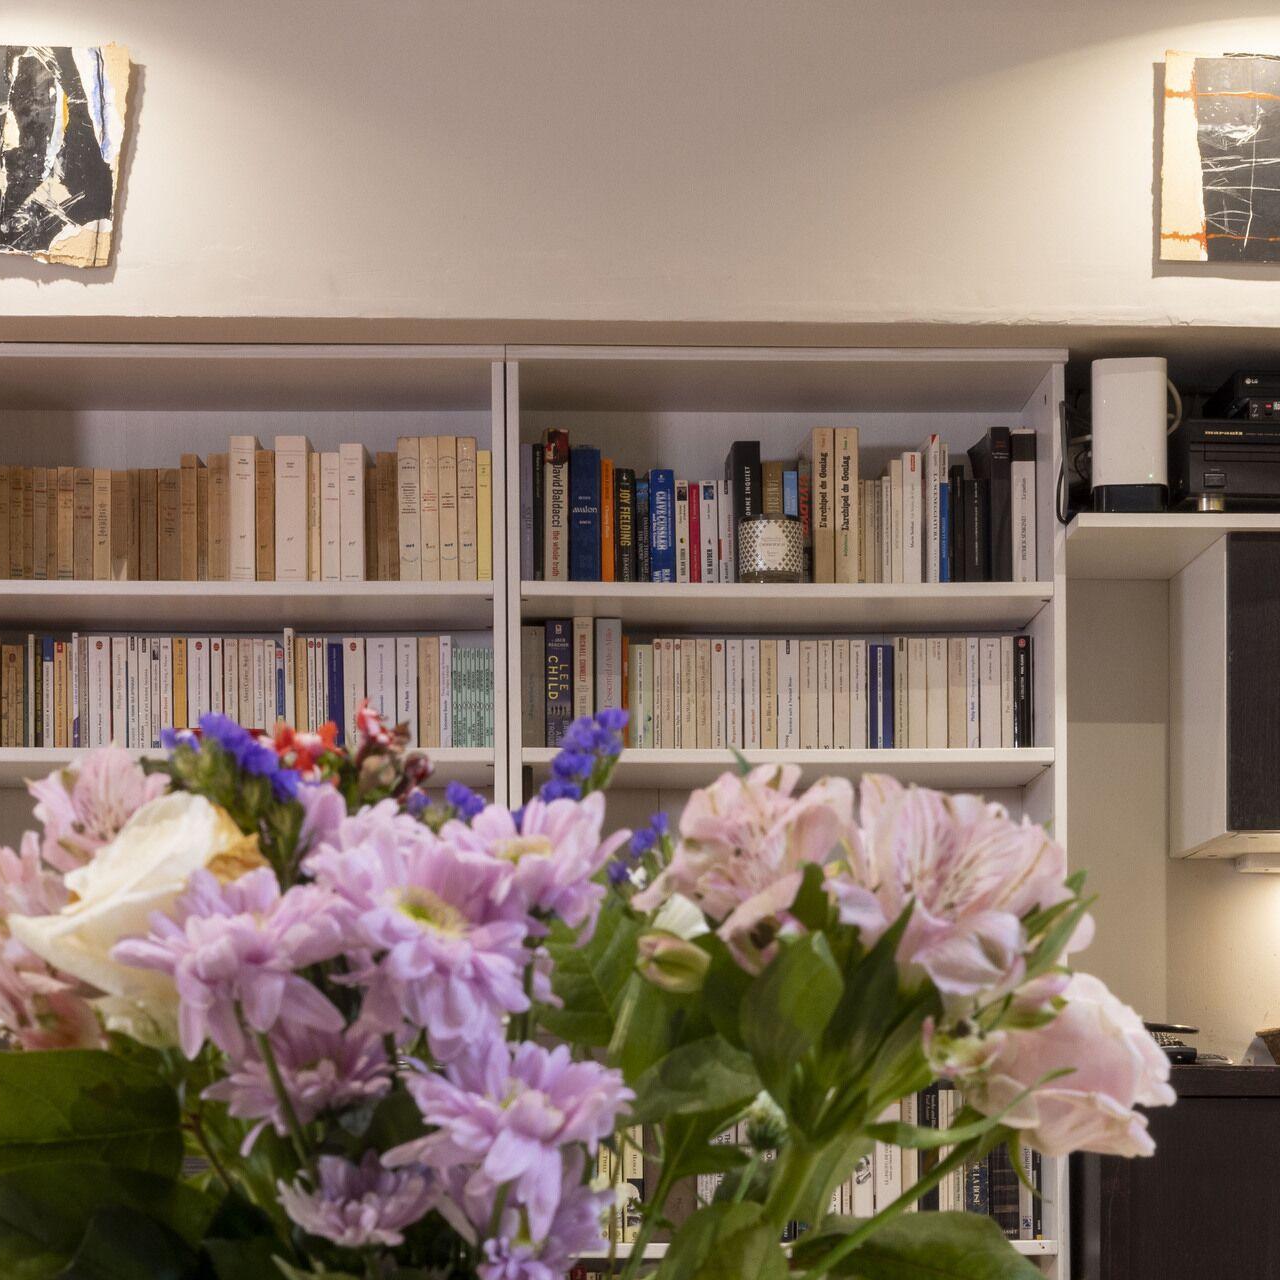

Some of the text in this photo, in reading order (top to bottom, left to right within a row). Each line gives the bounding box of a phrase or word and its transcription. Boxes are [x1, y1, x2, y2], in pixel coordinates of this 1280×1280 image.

[744, 465, 752, 495] INQUIET
[818, 452, 830, 479] Goulag
[840, 455, 852, 482] Goulag
[552, 463, 563, 528] David Baldacci
[818, 491, 830, 528] L'archipel
[840, 494, 852, 531] L'archipel
[619, 489, 631, 546] JOY FIELDING
[548, 655, 559, 700] CHILD
[560, 663, 569, 691] LEE
